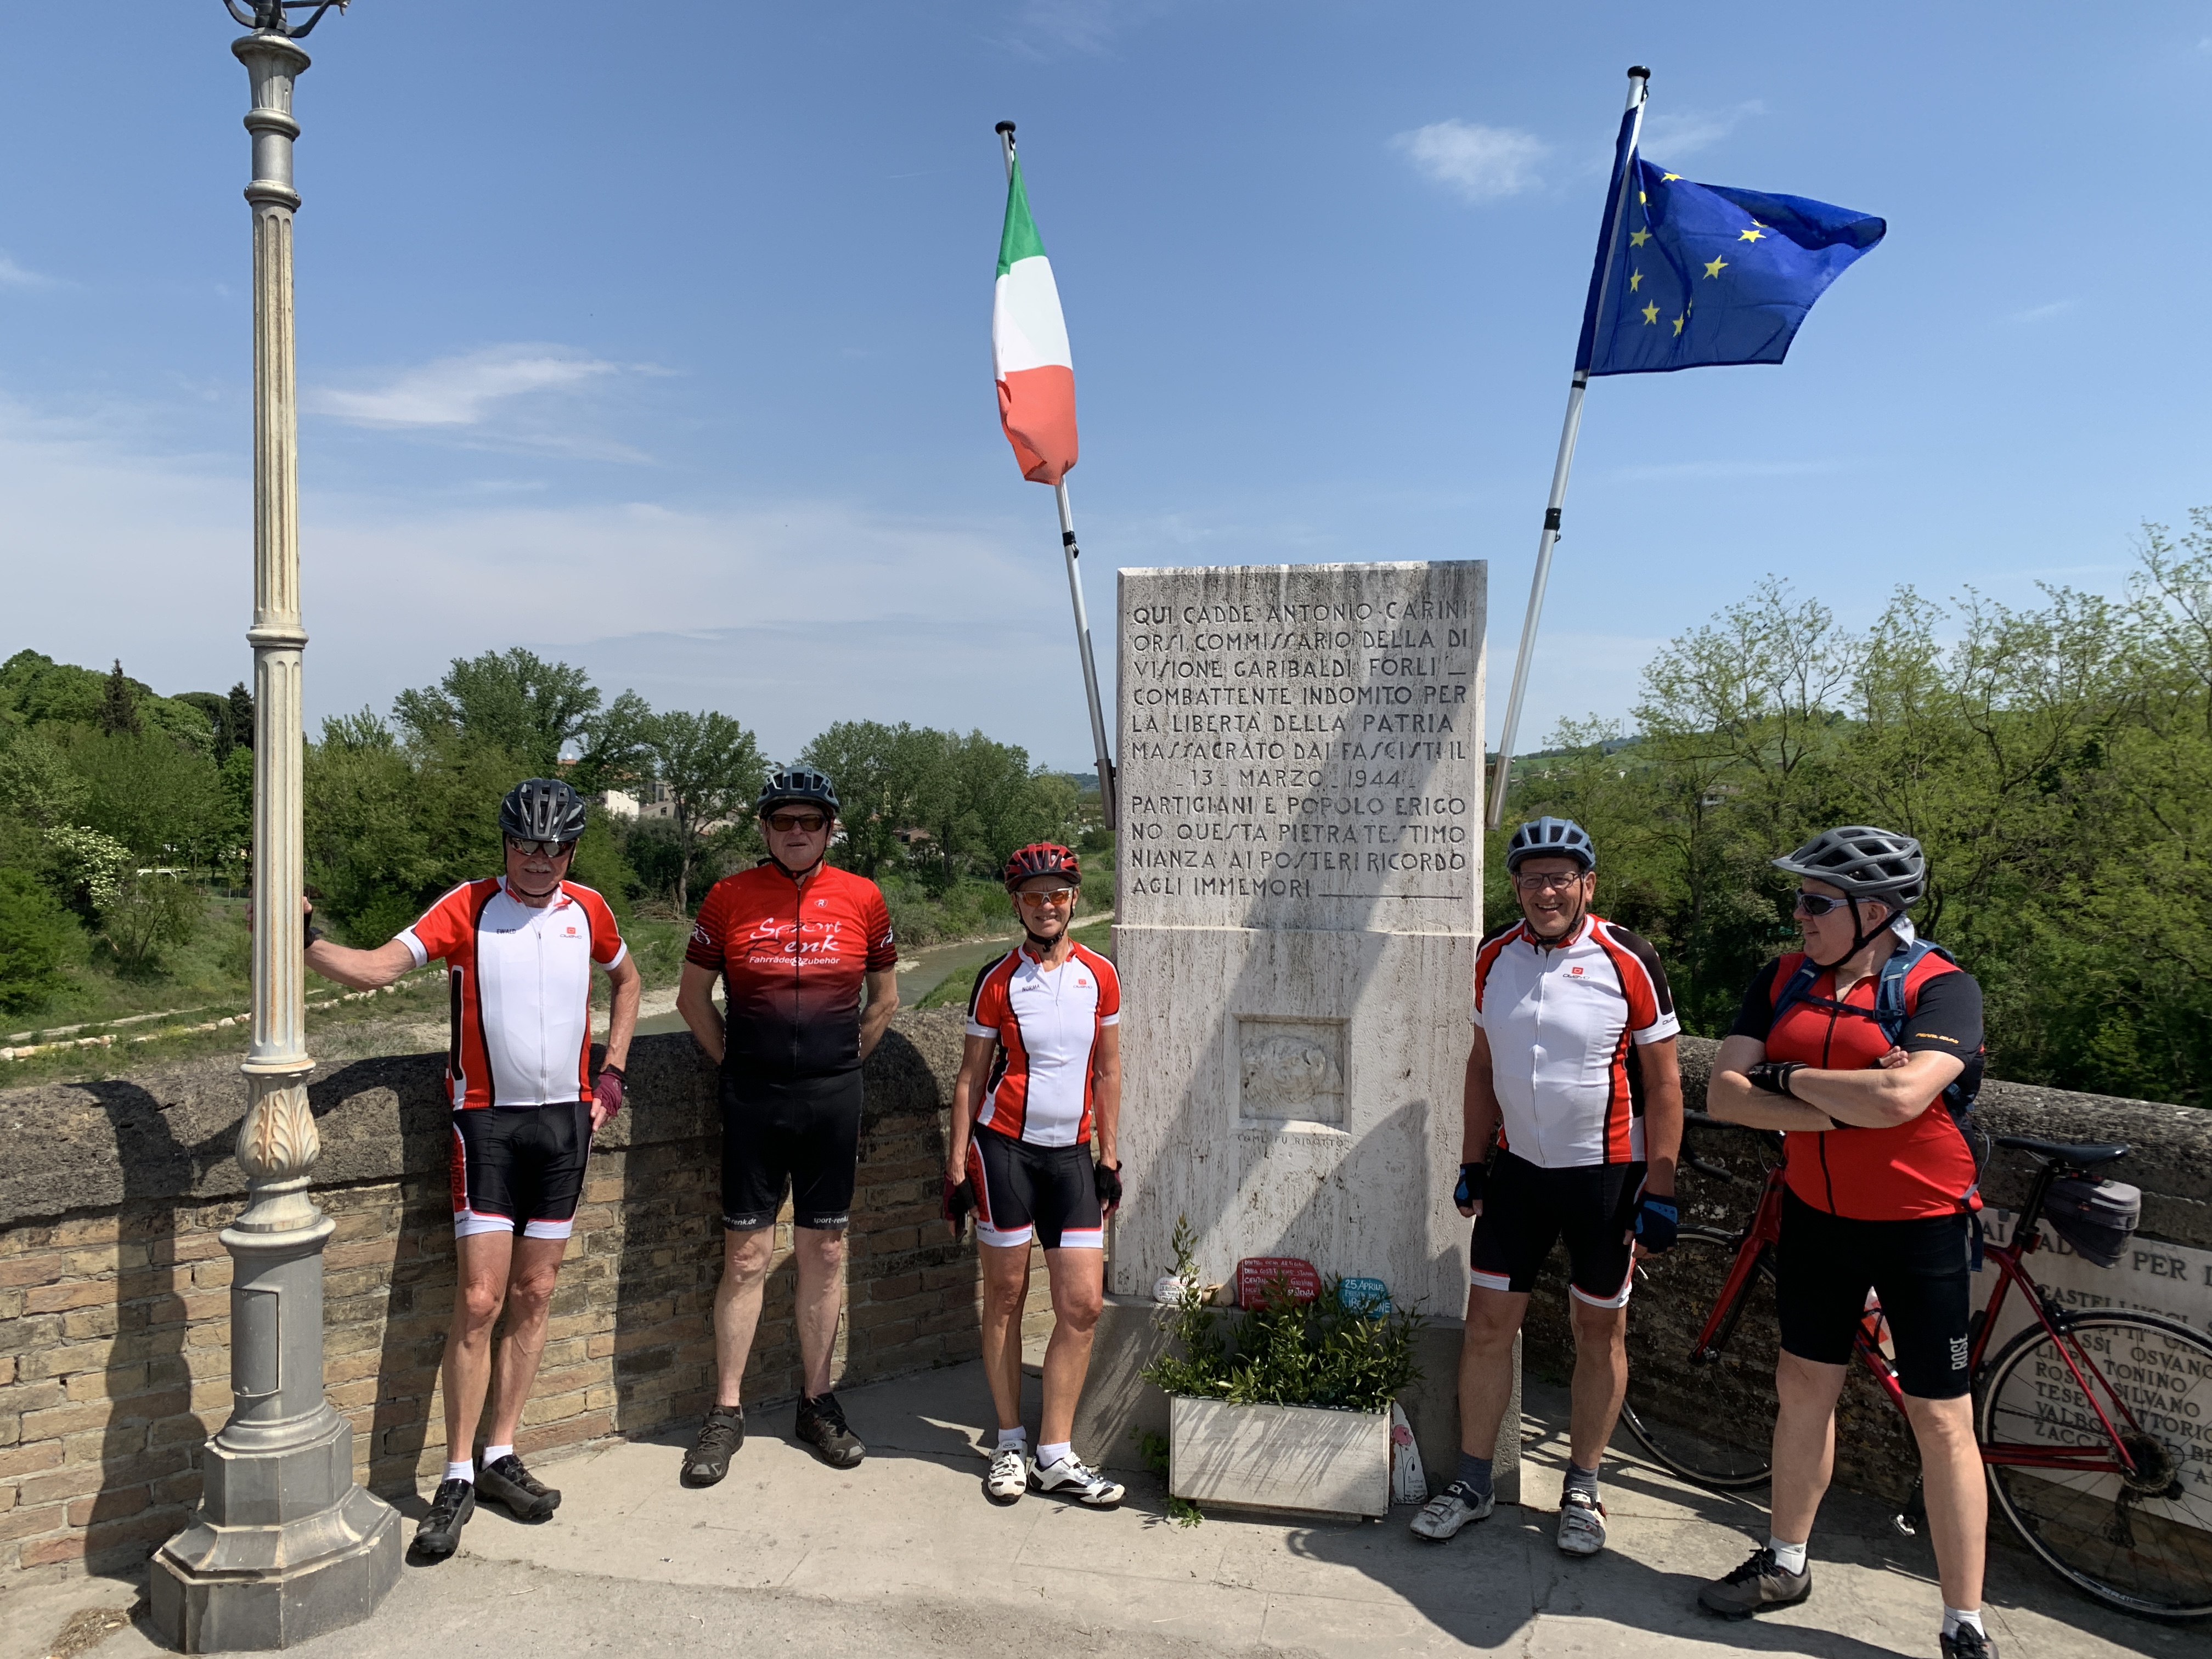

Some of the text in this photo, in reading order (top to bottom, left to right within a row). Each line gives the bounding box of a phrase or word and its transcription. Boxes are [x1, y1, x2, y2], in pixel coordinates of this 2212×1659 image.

[1133, 601, 1468, 626] QUI CADDE ANTONIO CARINI
[1133, 629, 1468, 653] ORSI COMMISSARIO DELLA DI
[1135, 660, 1223, 679] VISIONE
[1234, 659, 1351, 678] GARIBALDI
[1133, 685, 1466, 706] COMBATTENTE INDOMITO PER
[1132, 711, 1453, 733] LA LIBERTÀ DELLA PATRIA
[1132, 741, 1466, 760] MASSACRATO DAI FASCISTI IL
[1191, 769, 1400, 788] 13 MARZO 1944
[1131, 796, 1466, 816] PARTIGIANI E POPOLO ERIGO
[1131, 823, 1466, 844] NO QUESTA PIETRA TESTIMO
[1131, 851, 1466, 872] NIANZA AI POSTERI RICORDO
[1131, 878, 1310, 898] AGLI IMMEMORI
[744, 935, 840, 958] Renk
[1022, 984, 1040, 992] NORMA
[2133, 1250, 2188, 1282] PER
[1345, 1279, 1385, 1291] 25 APRILE
[1950, 1333, 1968, 1370] ROSE
[2103, 1358, 2187, 1393] TONINO
[2112, 1383, 2200, 1418] SILVANO
